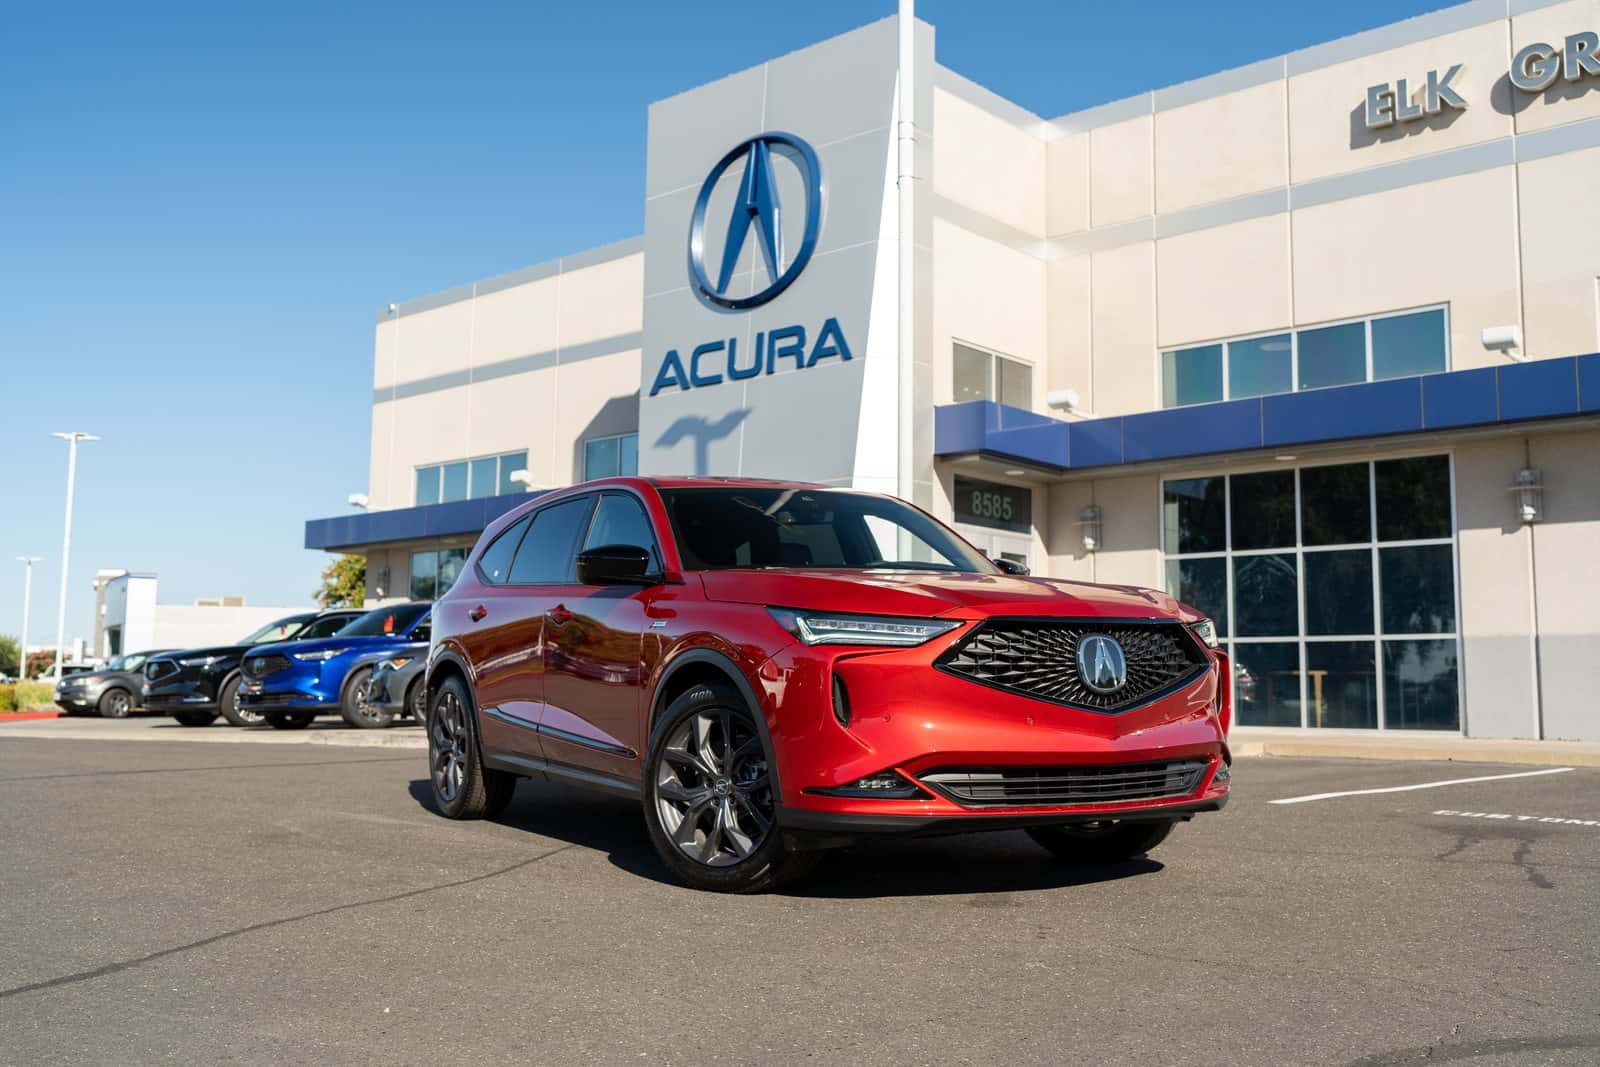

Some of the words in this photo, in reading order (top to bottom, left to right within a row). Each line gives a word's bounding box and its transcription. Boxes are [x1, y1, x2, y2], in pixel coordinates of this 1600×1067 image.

[1365, 63, 1467, 128] ELK
[1510, 31, 1600, 92] GR
[649, 317, 853, 397] ACURA
[971, 490, 1012, 520] 8585
